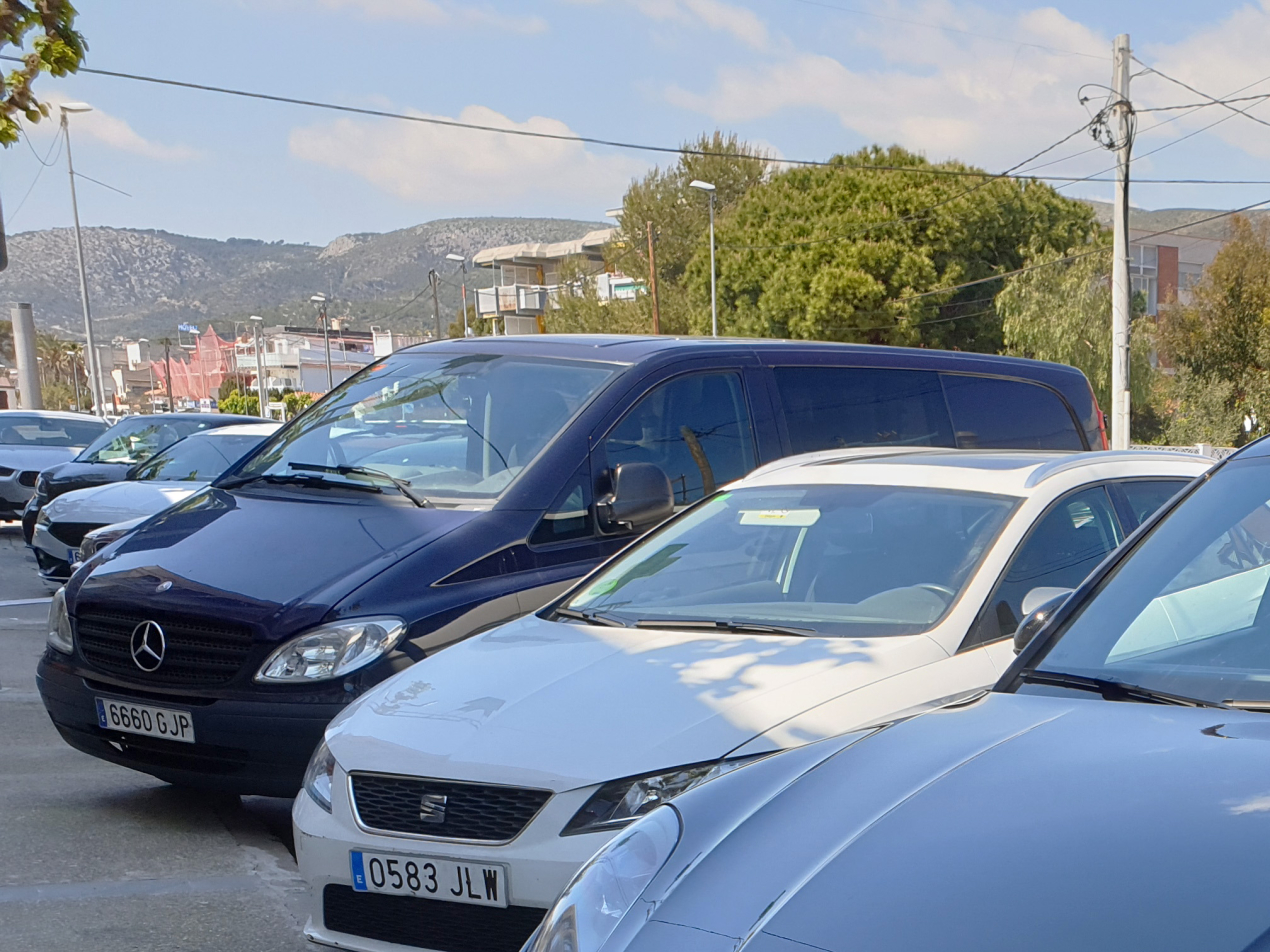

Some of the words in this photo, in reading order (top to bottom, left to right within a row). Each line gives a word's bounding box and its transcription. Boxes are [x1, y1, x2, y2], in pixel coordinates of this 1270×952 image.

[109, 703, 153, 732] 6660
[155, 712, 189, 738] GJP
[356, 874, 364, 884] E
[369, 857, 438, 894] 0583
[450, 866, 498, 901] JLW
